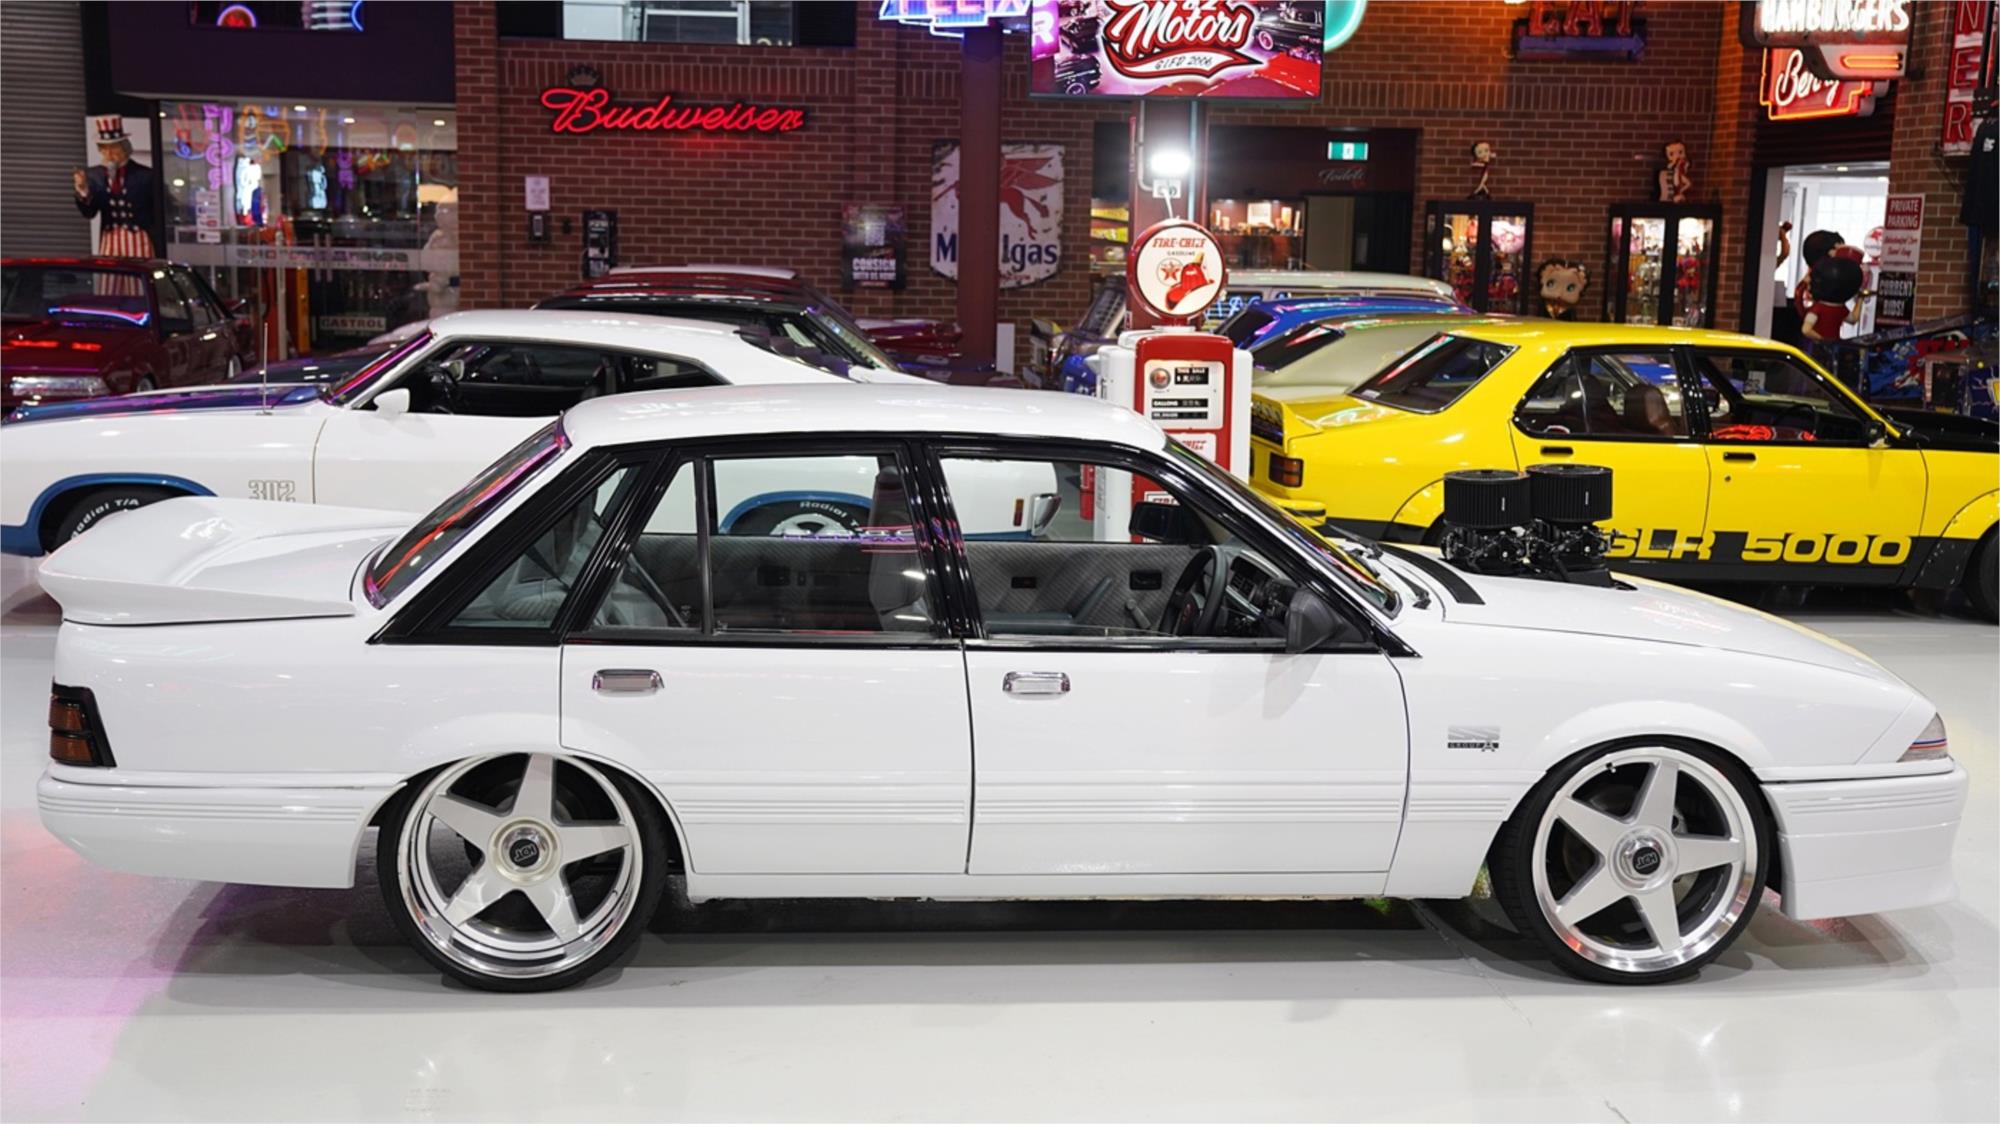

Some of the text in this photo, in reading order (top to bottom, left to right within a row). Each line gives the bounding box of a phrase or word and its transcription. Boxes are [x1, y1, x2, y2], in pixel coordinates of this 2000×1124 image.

[1110, 1, 1248, 56] Motors
[541, 88, 804, 133] Budweiser
[1890, 199, 1920, 212] PRIVATE
[1887, 215, 1918, 228] PARKING
[936, 232, 1058, 273] Mlgas
[852, 257, 896, 271] CONSIGN
[321, 318, 385, 329] CASTROL
[248, 479, 297, 503] 302
[114, 498, 140, 507] T/A
[800, 501, 848, 518] Radial
[1741, 530, 1912, 565] 5000
